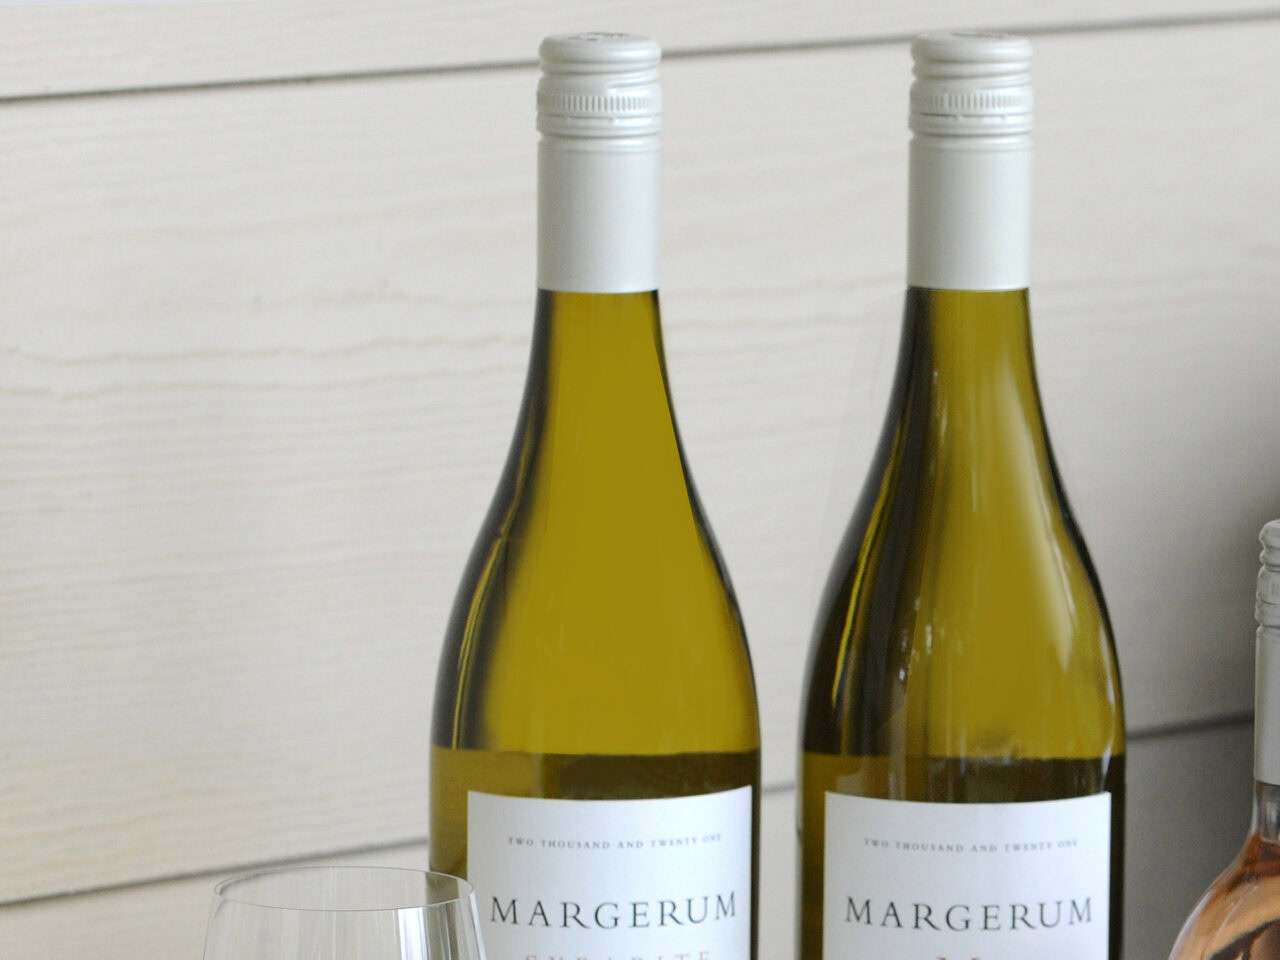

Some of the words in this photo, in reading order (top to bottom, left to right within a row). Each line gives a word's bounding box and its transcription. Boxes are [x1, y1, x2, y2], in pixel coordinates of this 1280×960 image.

[508, 836, 534, 847] TWO
[540, 839, 611, 850] THOUSAND
[617, 839, 644, 850] AND
[650, 836, 698, 848] TWENTY
[863, 837, 890, 849] TWO
[895, 840, 965, 853] THOUSAND
[970, 843, 998, 853] AND
[1003, 841, 1052, 853] TWENTY
[490, 890, 736, 930] MARGERUM
[845, 895, 1092, 932] MARGERUM
